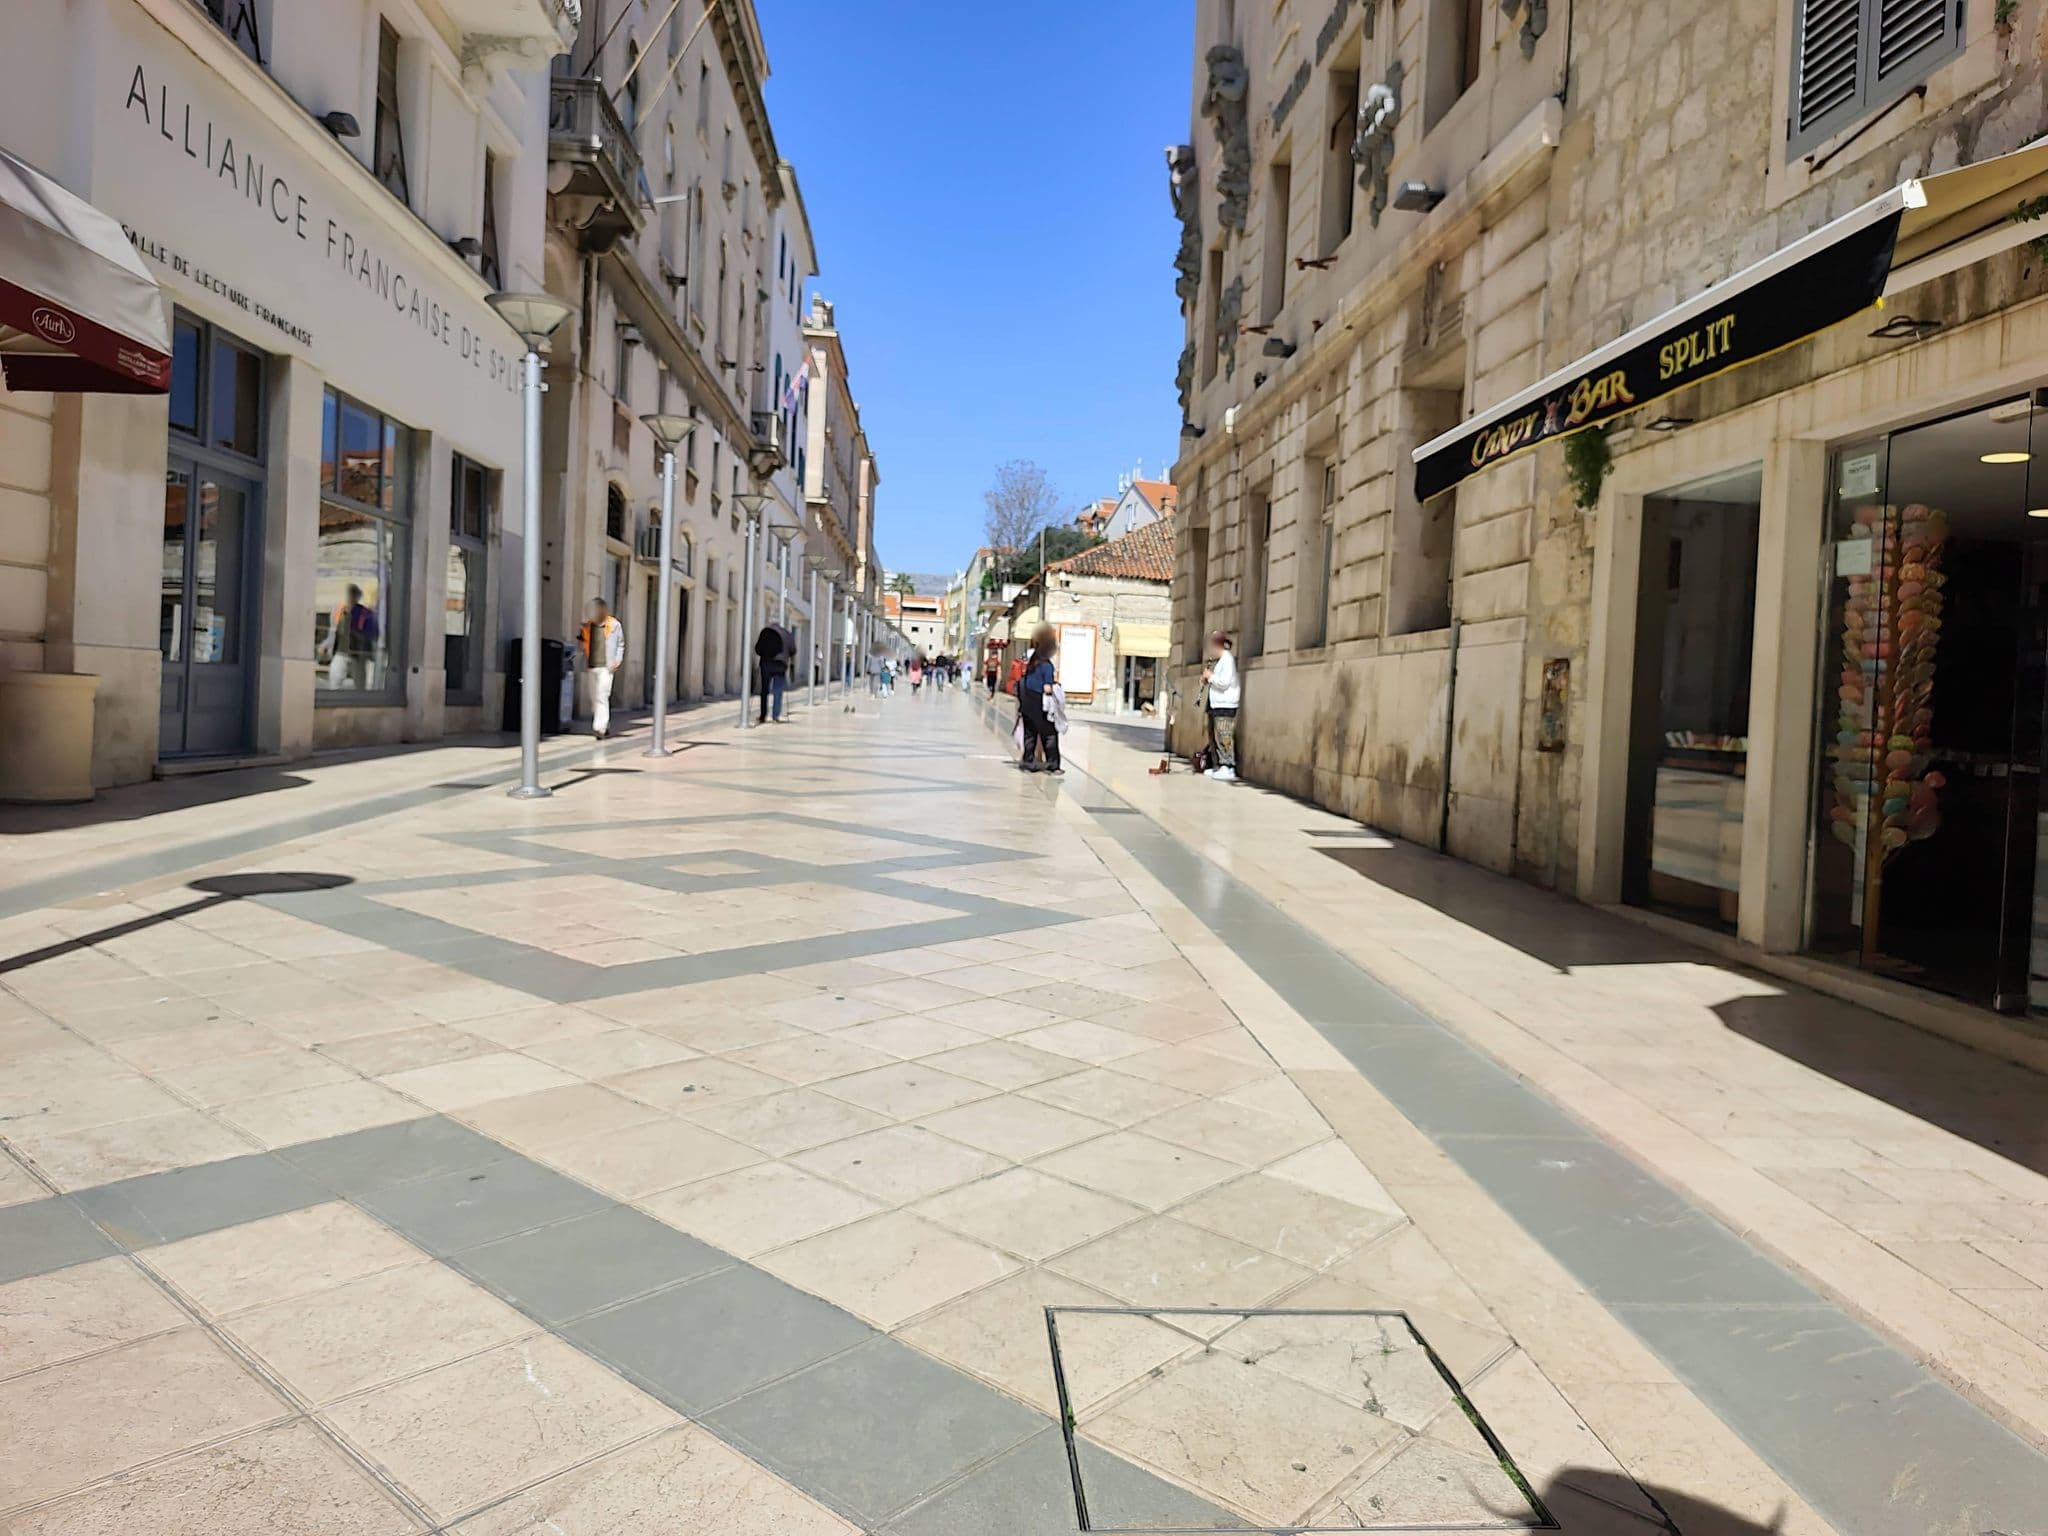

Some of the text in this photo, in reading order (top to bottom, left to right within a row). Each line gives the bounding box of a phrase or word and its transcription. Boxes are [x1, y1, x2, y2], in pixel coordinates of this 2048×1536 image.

[126, 65, 307, 239] ALLIANCE
[462, 325, 480, 368] DE
[489, 348, 525, 395] SPLI
[173, 254, 189, 277] DE
[195, 268, 250, 312] LECTURE
[1471, 313, 1736, 468] CANDY BAR SPLIT
